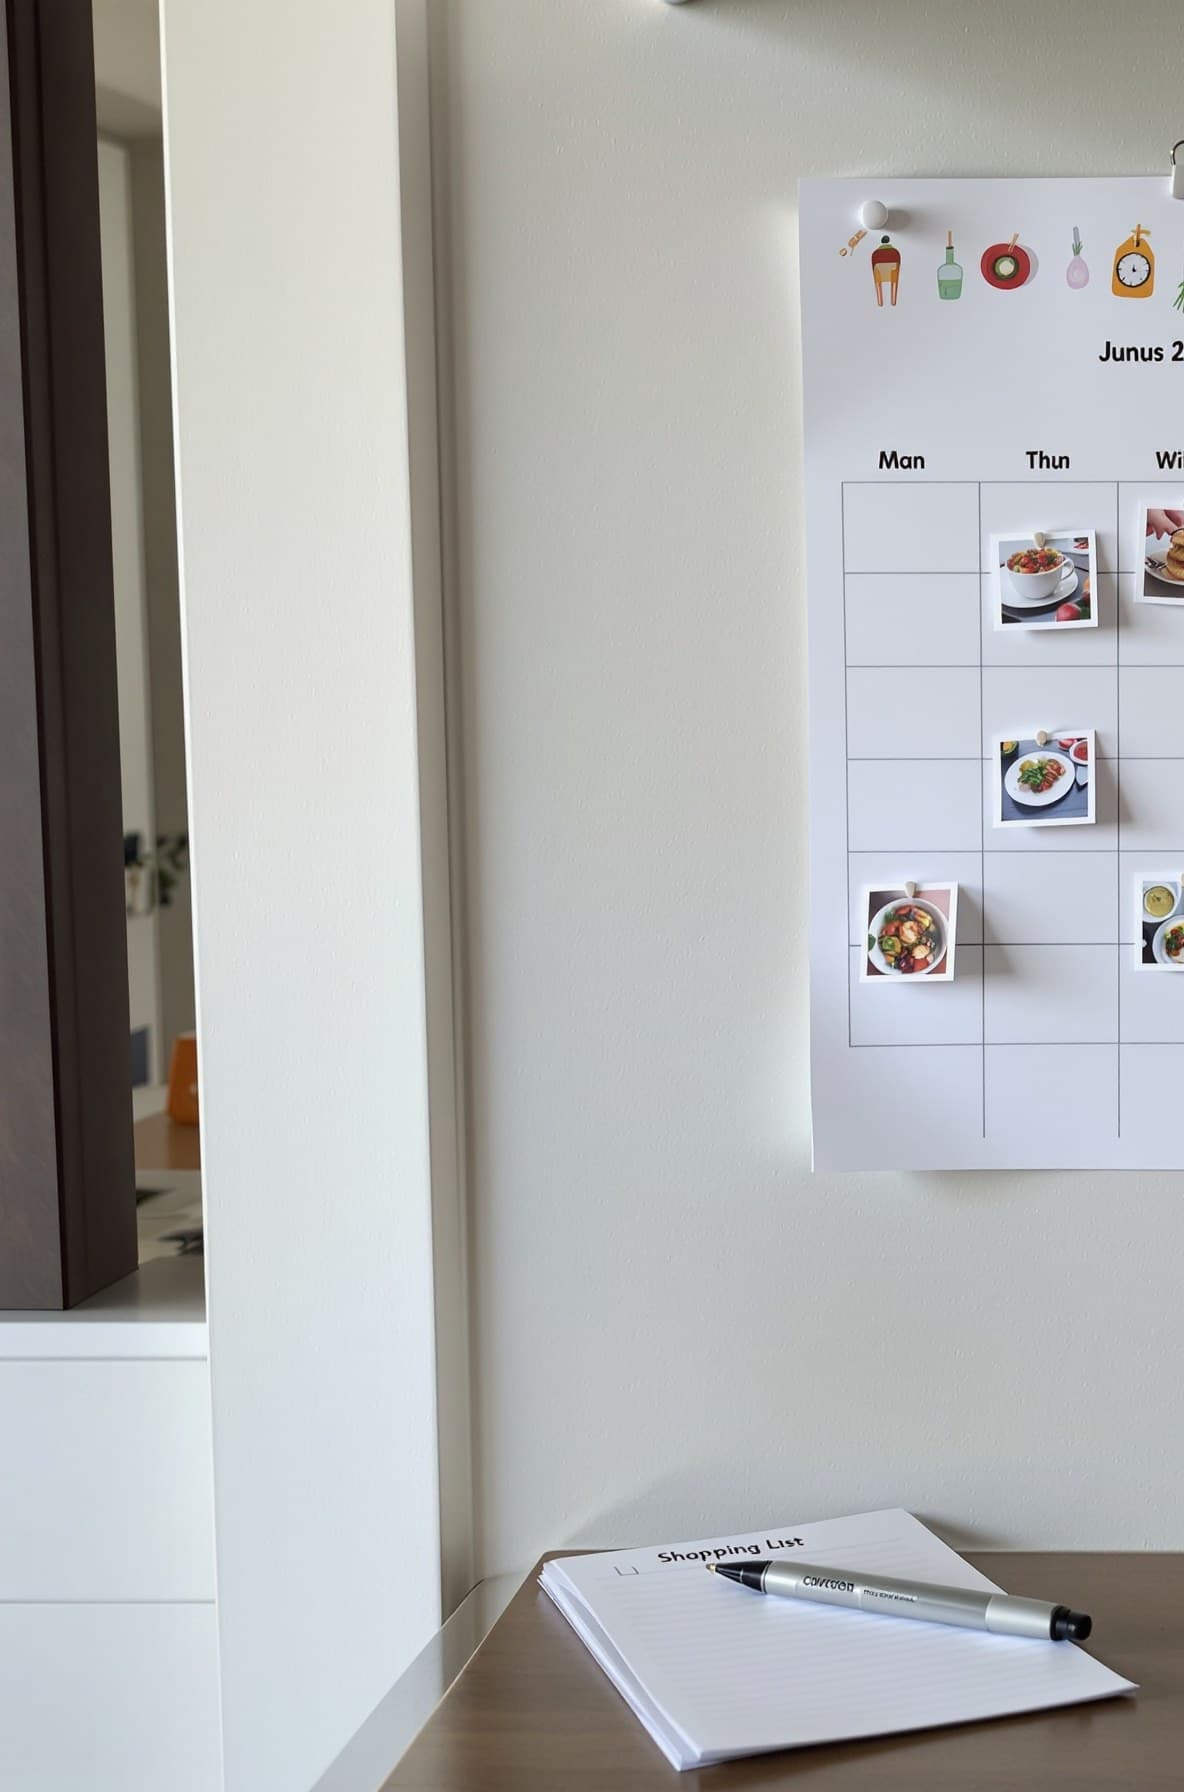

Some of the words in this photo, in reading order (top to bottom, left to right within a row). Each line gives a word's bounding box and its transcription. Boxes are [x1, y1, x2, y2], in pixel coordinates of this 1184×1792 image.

[1098, 341, 1163, 363] Junus
[878, 450, 925, 470] Man
[1025, 450, 1070, 470] Thun
[657, 1543, 761, 1562] Shopping
[766, 1537, 805, 1550] List
